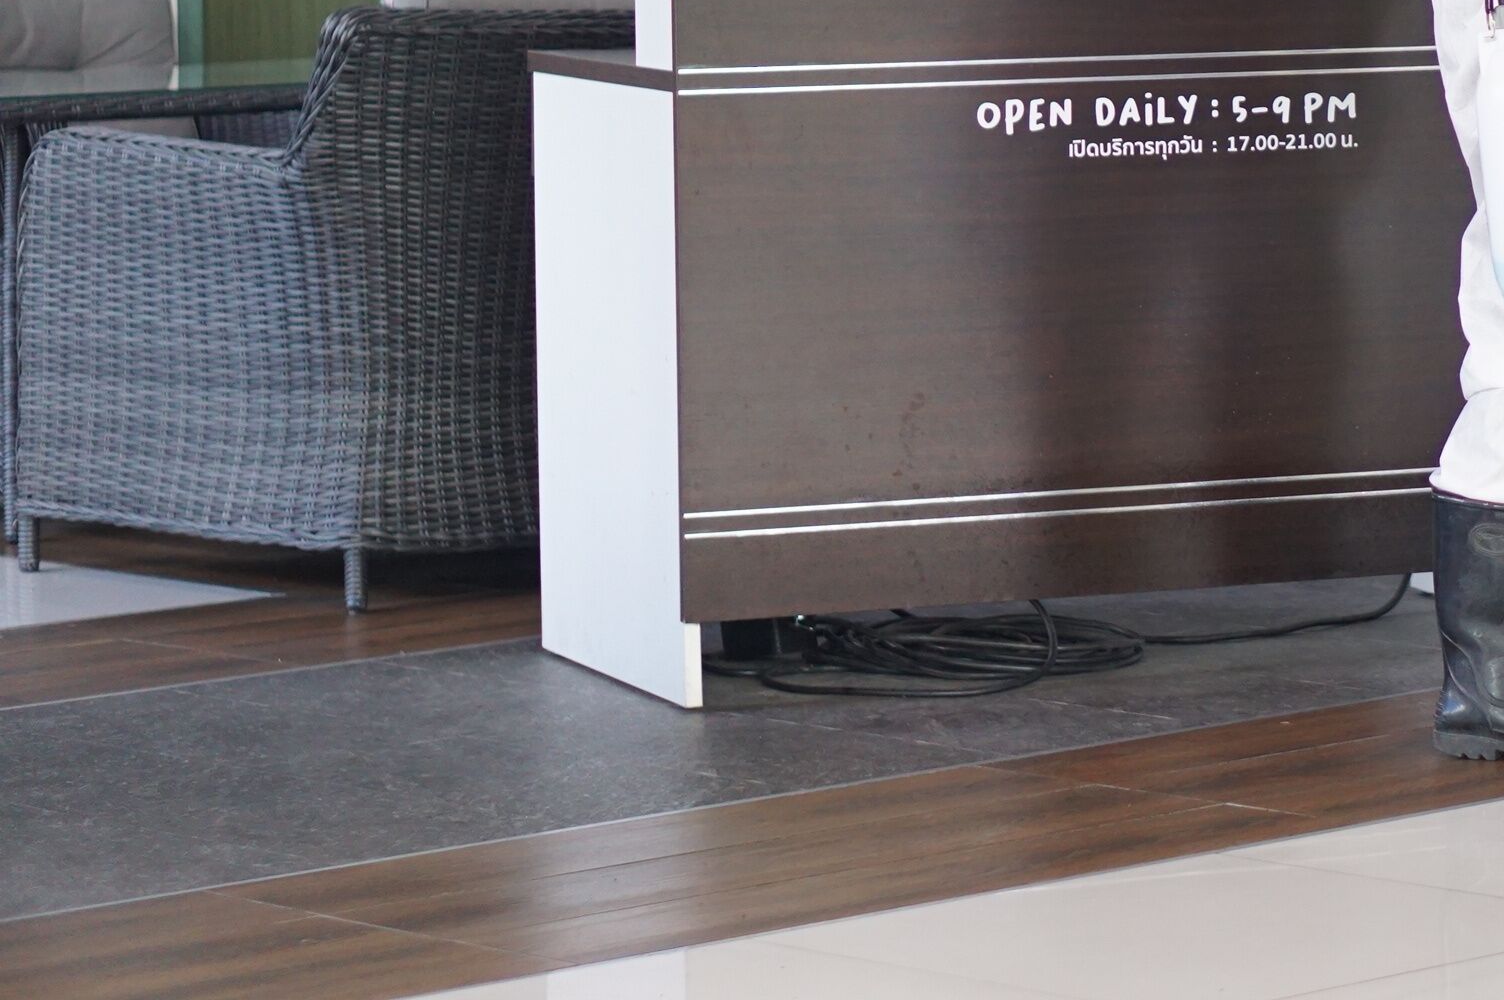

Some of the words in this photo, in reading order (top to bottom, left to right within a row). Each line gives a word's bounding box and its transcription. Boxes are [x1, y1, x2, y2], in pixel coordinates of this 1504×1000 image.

[976, 98, 1073, 135] OPEN
[1231, 95, 1292, 124] 5-9
[1303, 92, 1358, 124] PM
[1068, 134, 1203, 161] เปิดบริการทุกวัน
[1227, 133, 1337, 152] 17.00-21.00
[1341, 134, 1359, 149] น.
